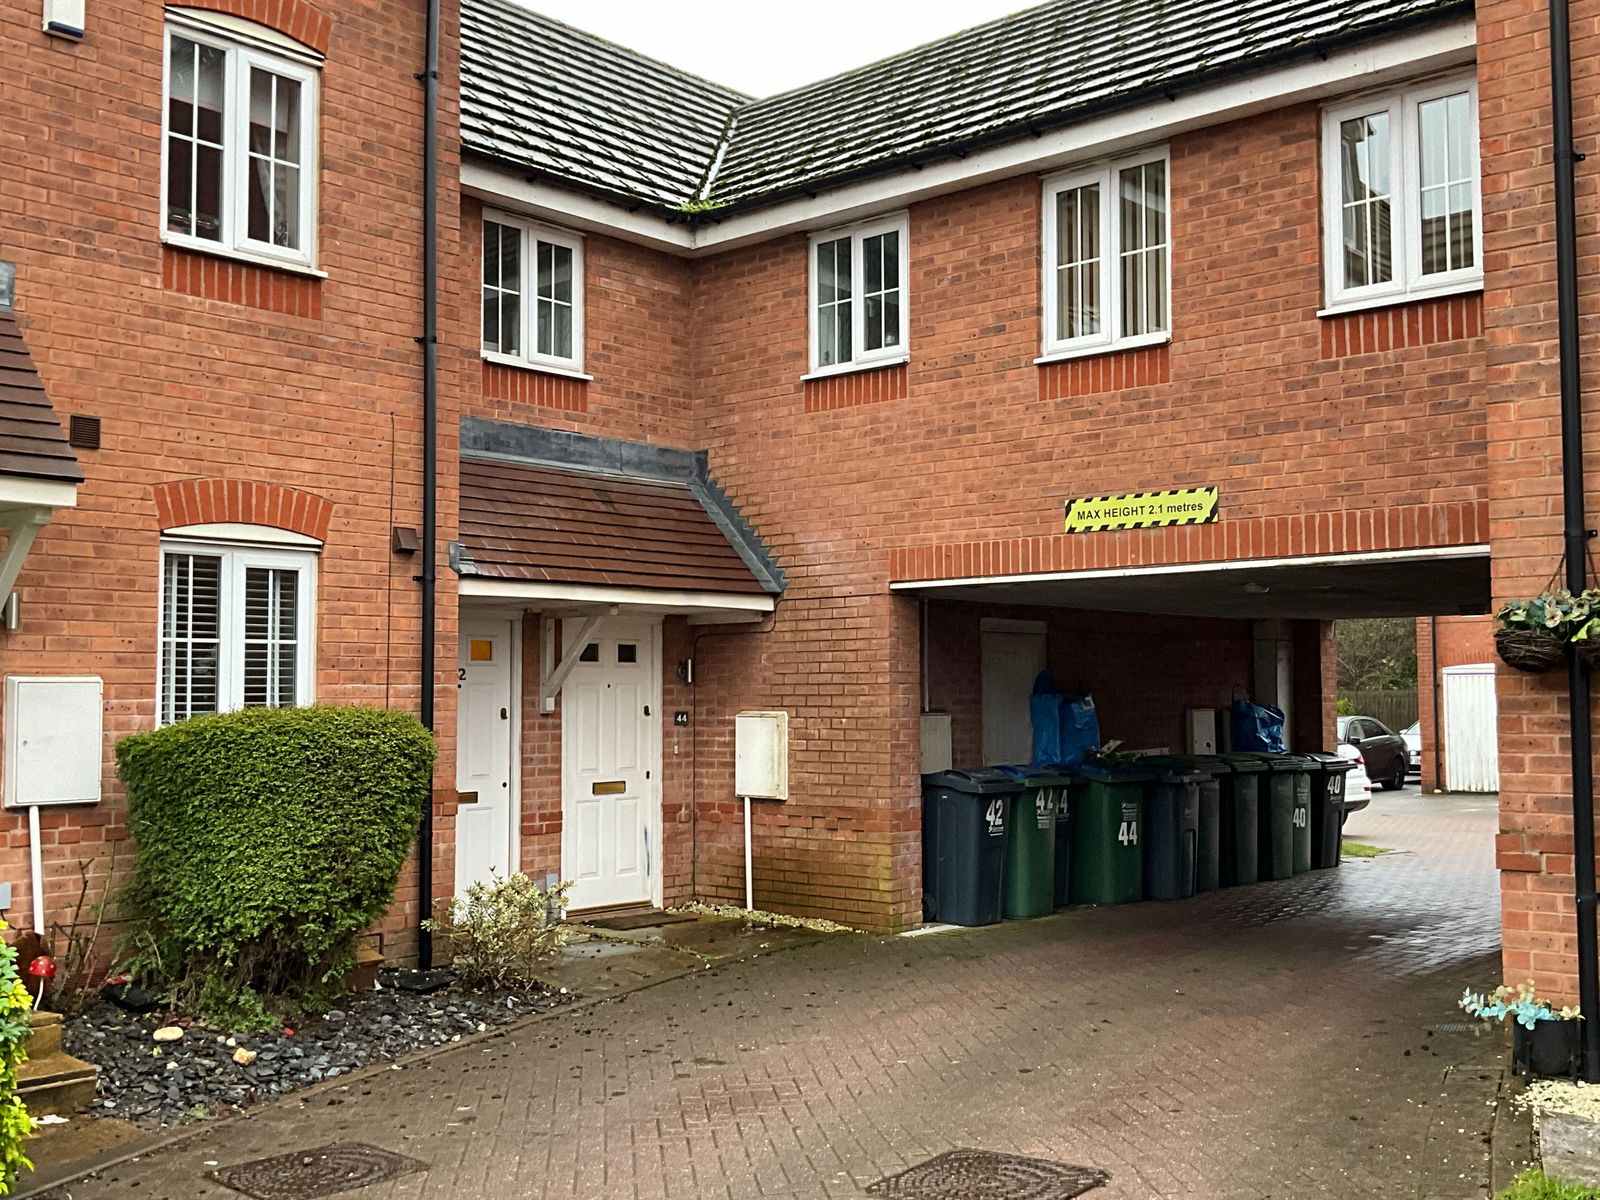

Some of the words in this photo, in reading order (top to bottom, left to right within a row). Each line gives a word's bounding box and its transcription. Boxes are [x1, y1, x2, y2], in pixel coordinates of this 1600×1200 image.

[1077, 510, 1100, 520] MAX
[1104, 505, 1145, 518] HEIGHT
[1148, 504, 1163, 515] 2.1
[1166, 502, 1203, 513] metres
[457, 668, 466, 680] 2
[676, 714, 687, 722] 44
[1327, 775, 1342, 795] 40
[985, 799, 1004, 825] 42
[1292, 807, 1306, 828] 40
[1118, 821, 1138, 846] 44
